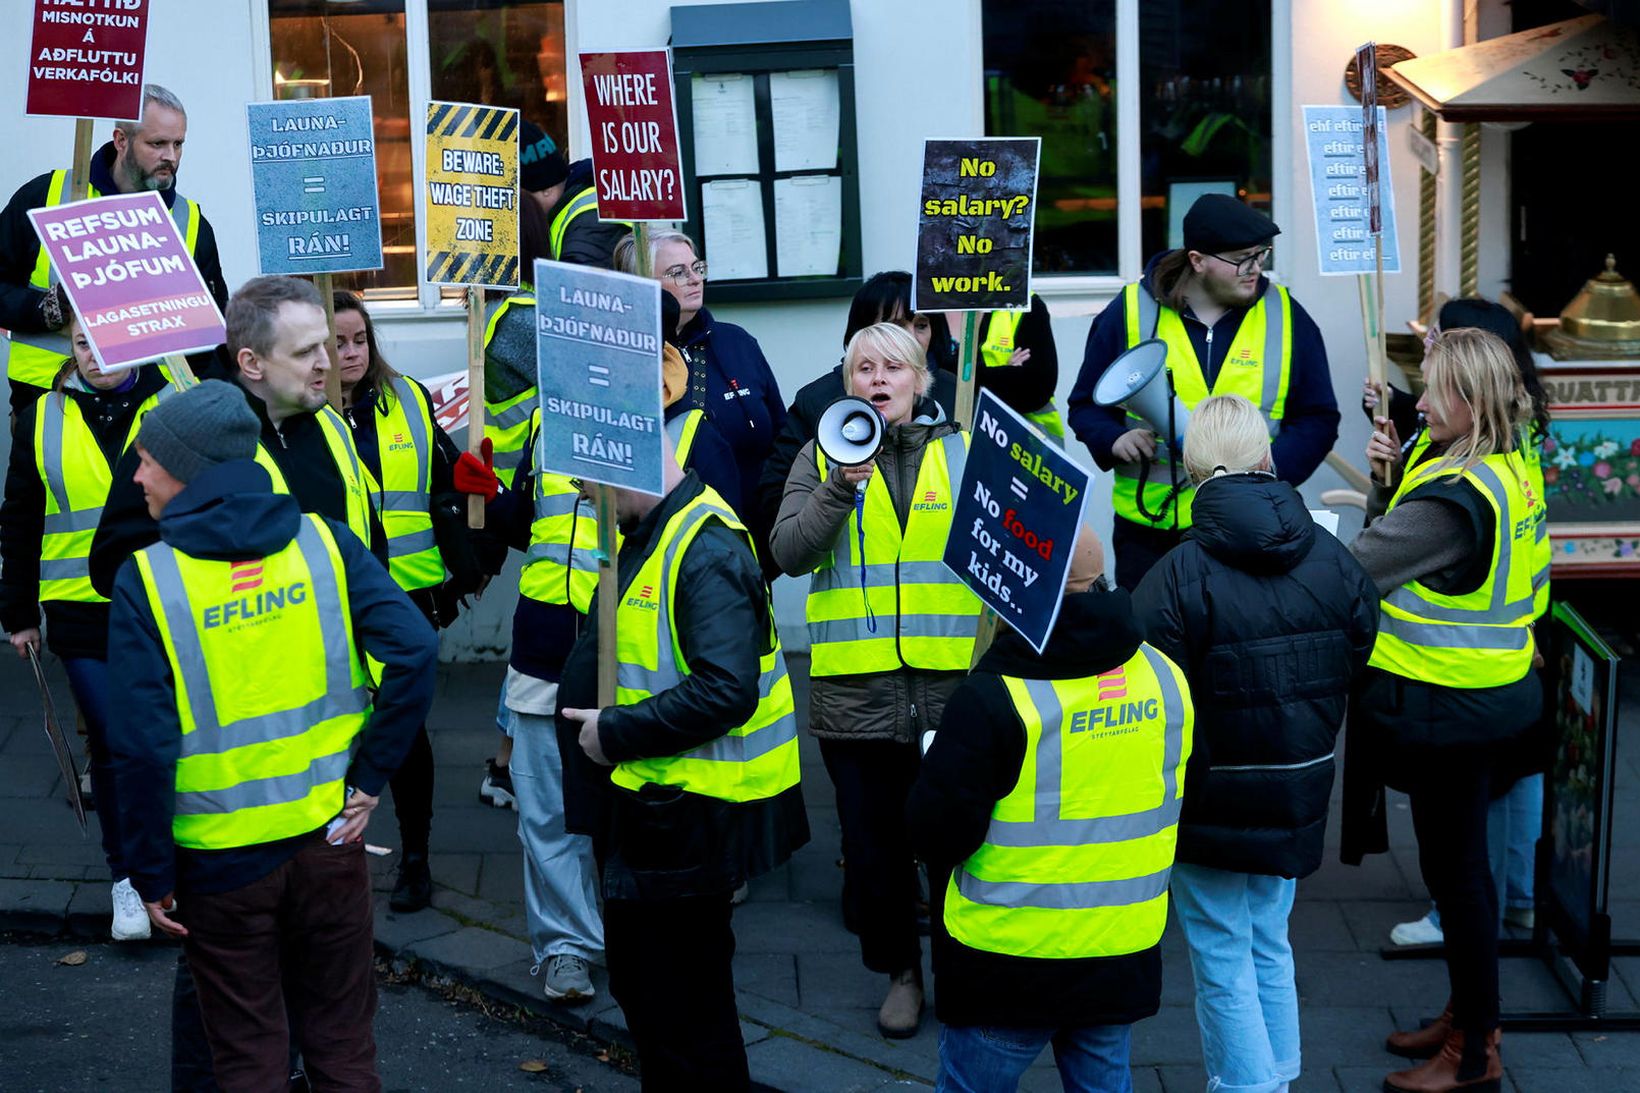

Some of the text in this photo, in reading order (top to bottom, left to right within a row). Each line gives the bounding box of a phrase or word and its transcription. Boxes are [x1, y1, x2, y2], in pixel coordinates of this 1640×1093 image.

[42, 11, 139, 28] MISNOTKUN
[82, 28, 95, 43] Á
[39, 48, 136, 66] AÐFLUTTU
[33, 66, 138, 84] VERKAFÓLKI
[594, 74, 658, 105] WHERE
[272, 115, 346, 132] LAUNA-
[253, 139, 372, 159] ÞJÓFNAÐUR
[602, 122, 662, 153] IS OUR
[1324, 140, 1354, 153] eftir
[442, 150, 504, 176] BEWARE:
[960, 158, 996, 177] No
[1327, 162, 1357, 175] eftir
[430, 182, 514, 210] WAGE THEFT
[600, 168, 674, 201] SALARY?
[1328, 184, 1359, 196] eftir
[262, 207, 372, 225] SKIPULAGT
[924, 195, 1029, 220] salary?
[1330, 205, 1360, 217] eftir
[44, 207, 163, 242] REFSUM
[456, 218, 492, 242] ZONE
[62, 234, 168, 263] LAUNA-
[288, 232, 350, 255] RÁN!
[958, 235, 992, 254] No
[1330, 248, 1360, 261] eftir
[71, 254, 185, 290] ÞJÓFUM
[931, 272, 1011, 292] work.
[84, 295, 209, 328] LAGASETNINGU
[560, 286, 632, 314] LAUNA-
[128, 315, 186, 337] STRAX
[540, 314, 656, 351] ÞJÓFNAÐUR
[548, 398, 655, 432] SKIPULAGT
[572, 432, 633, 464] RÁN!
[980, 410, 1078, 505] No salary
[974, 480, 1054, 560] No food
[971, 518, 1039, 588] for my
[968, 551, 1022, 614] kids..
[204, 582, 306, 630] EFLING
[1070, 698, 1158, 734] EFLING
